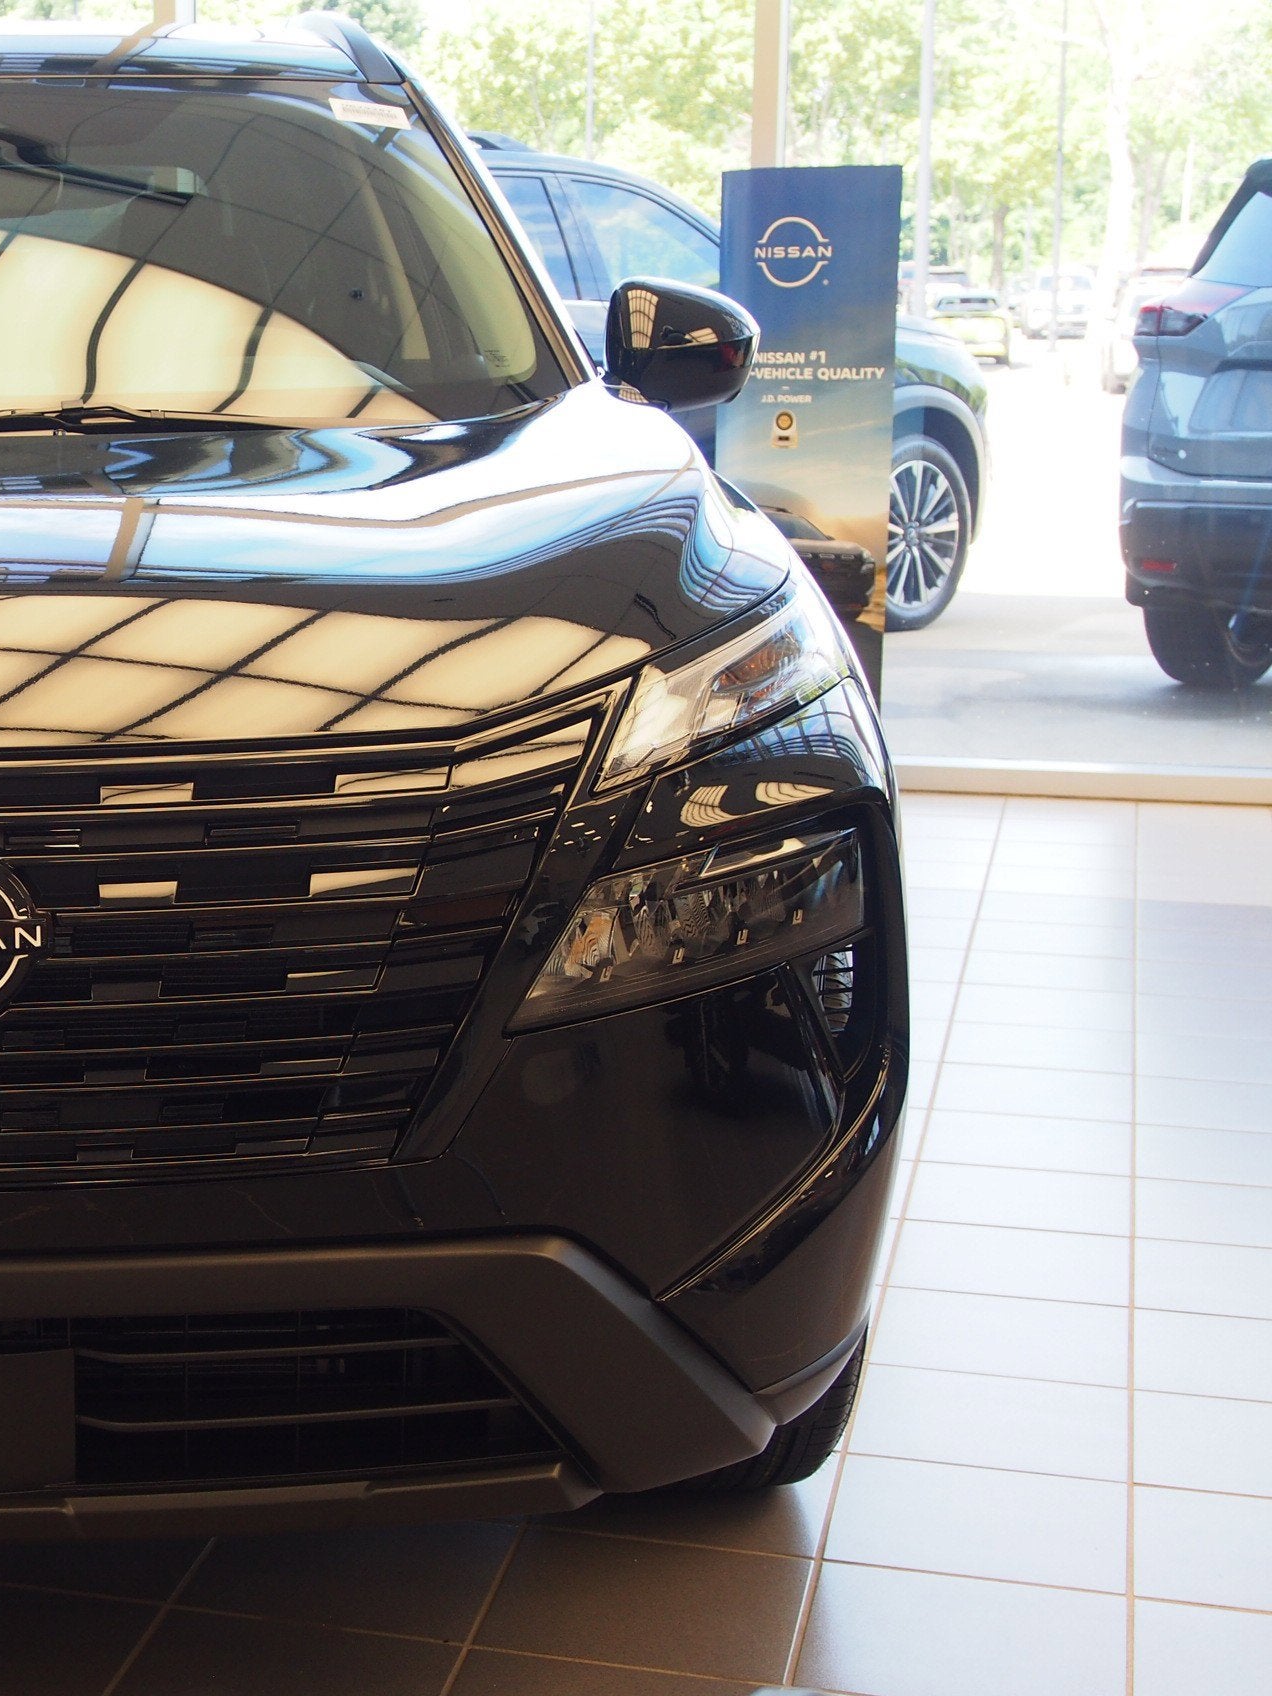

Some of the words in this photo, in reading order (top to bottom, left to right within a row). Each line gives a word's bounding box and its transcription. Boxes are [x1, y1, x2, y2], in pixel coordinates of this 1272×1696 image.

[754, 245, 832, 259] NISSAN
[753, 351, 806, 364] NISSAN
[809, 350, 827, 364] #1
[816, 366, 886, 381] QUALITY
[777, 394, 813, 403] POWER
